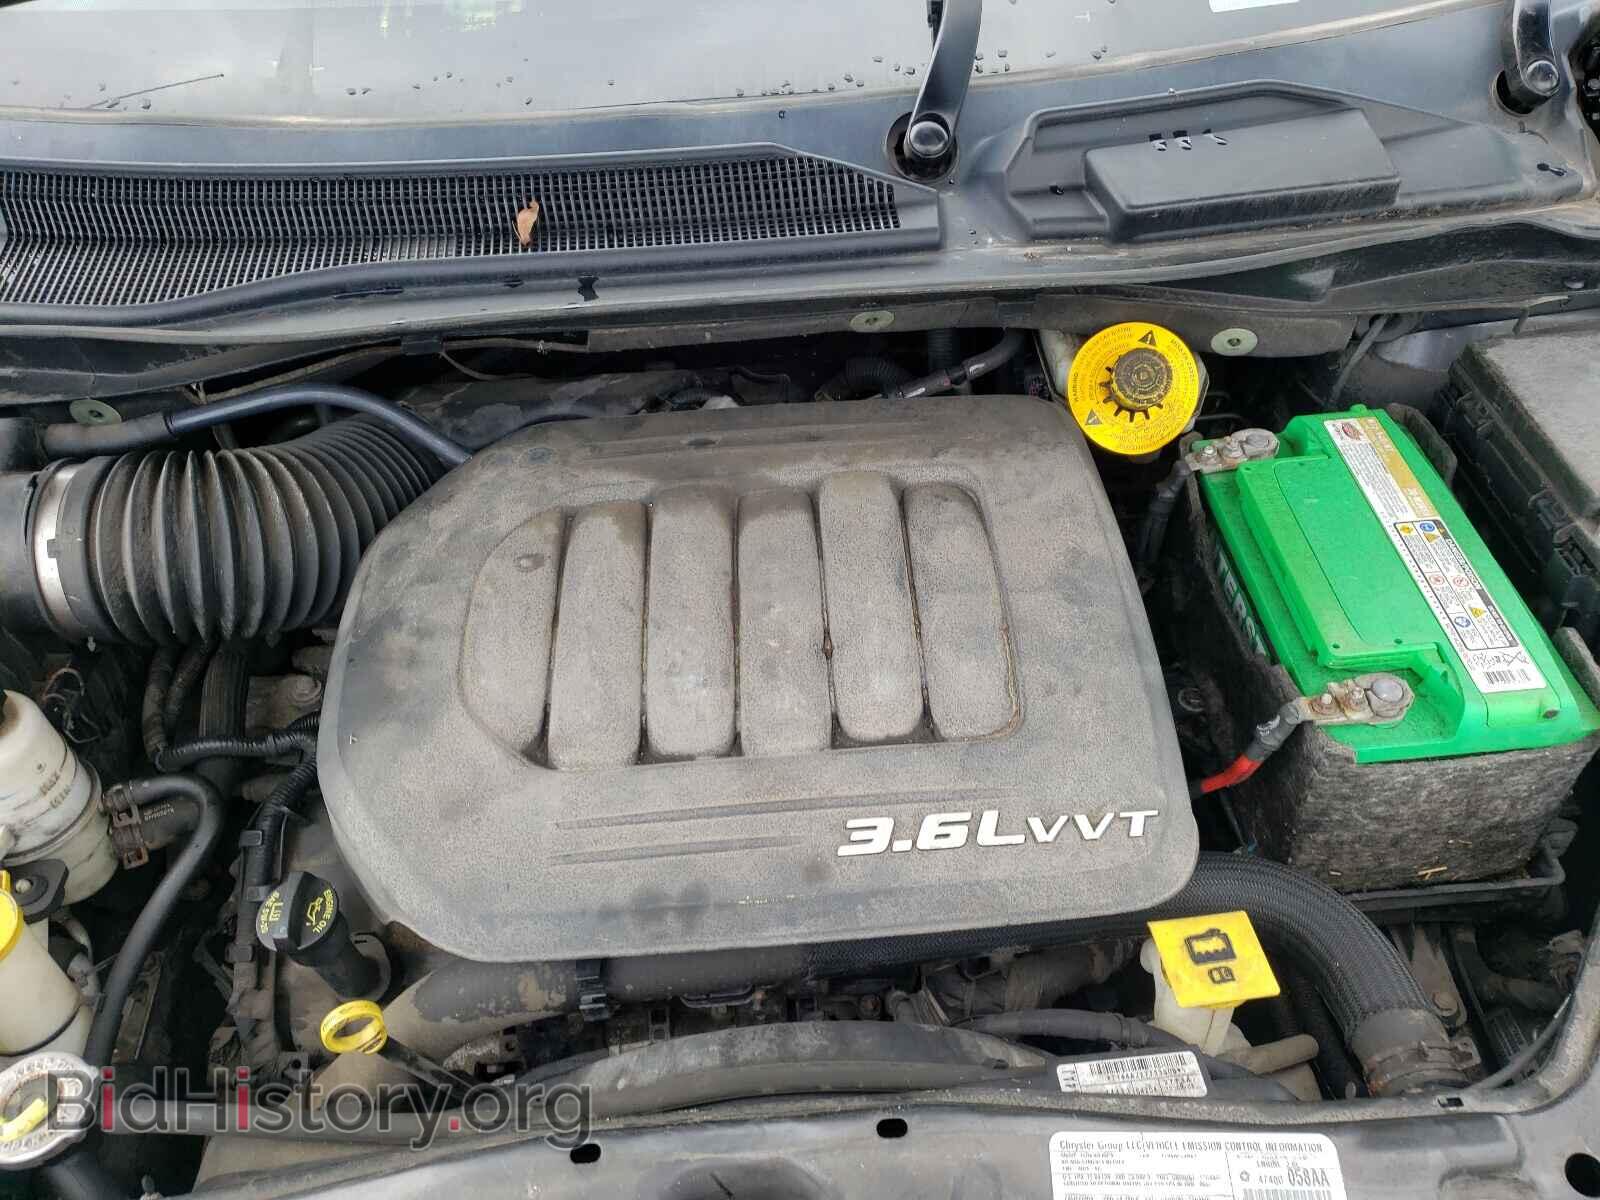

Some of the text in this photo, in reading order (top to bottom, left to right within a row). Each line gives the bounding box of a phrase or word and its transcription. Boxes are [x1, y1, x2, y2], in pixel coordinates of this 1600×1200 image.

[312, 919, 328, 935] OIL
[1060, 1139, 1095, 1153] Chrysler
[1096, 1140, 1123, 1153] Group
[1145, 1140, 1179, 1152] VEHICLE
[1182, 1141, 1222, 1152] EMISSION
[1225, 1141, 1263, 1153] CONTROL
[1265, 1142, 1323, 1154] INFORMATION
[1286, 1168, 1331, 1188] 058AA
